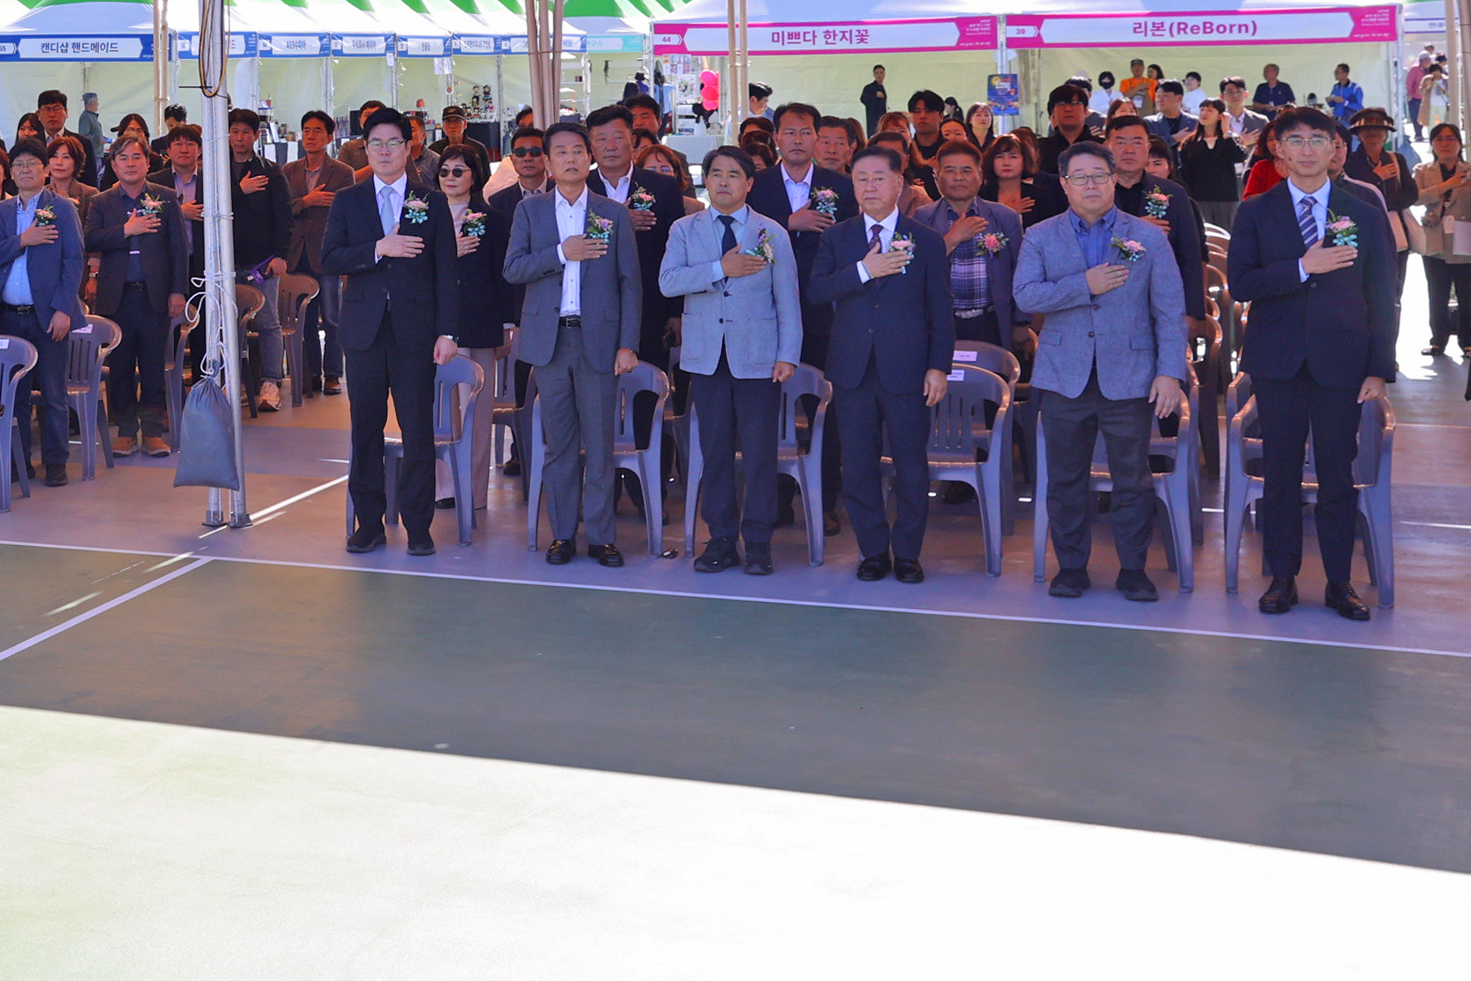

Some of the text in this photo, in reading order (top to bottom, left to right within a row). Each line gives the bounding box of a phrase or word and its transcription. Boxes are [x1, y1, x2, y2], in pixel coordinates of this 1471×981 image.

[1015, 28, 1026, 36] 39
[1132, 20, 1258, 38] 리본(ReBorn)
[771, 29, 870, 46] 미쁘다 한지꽃
[40, 42, 119, 54] 캔디샵 핸드메이드
